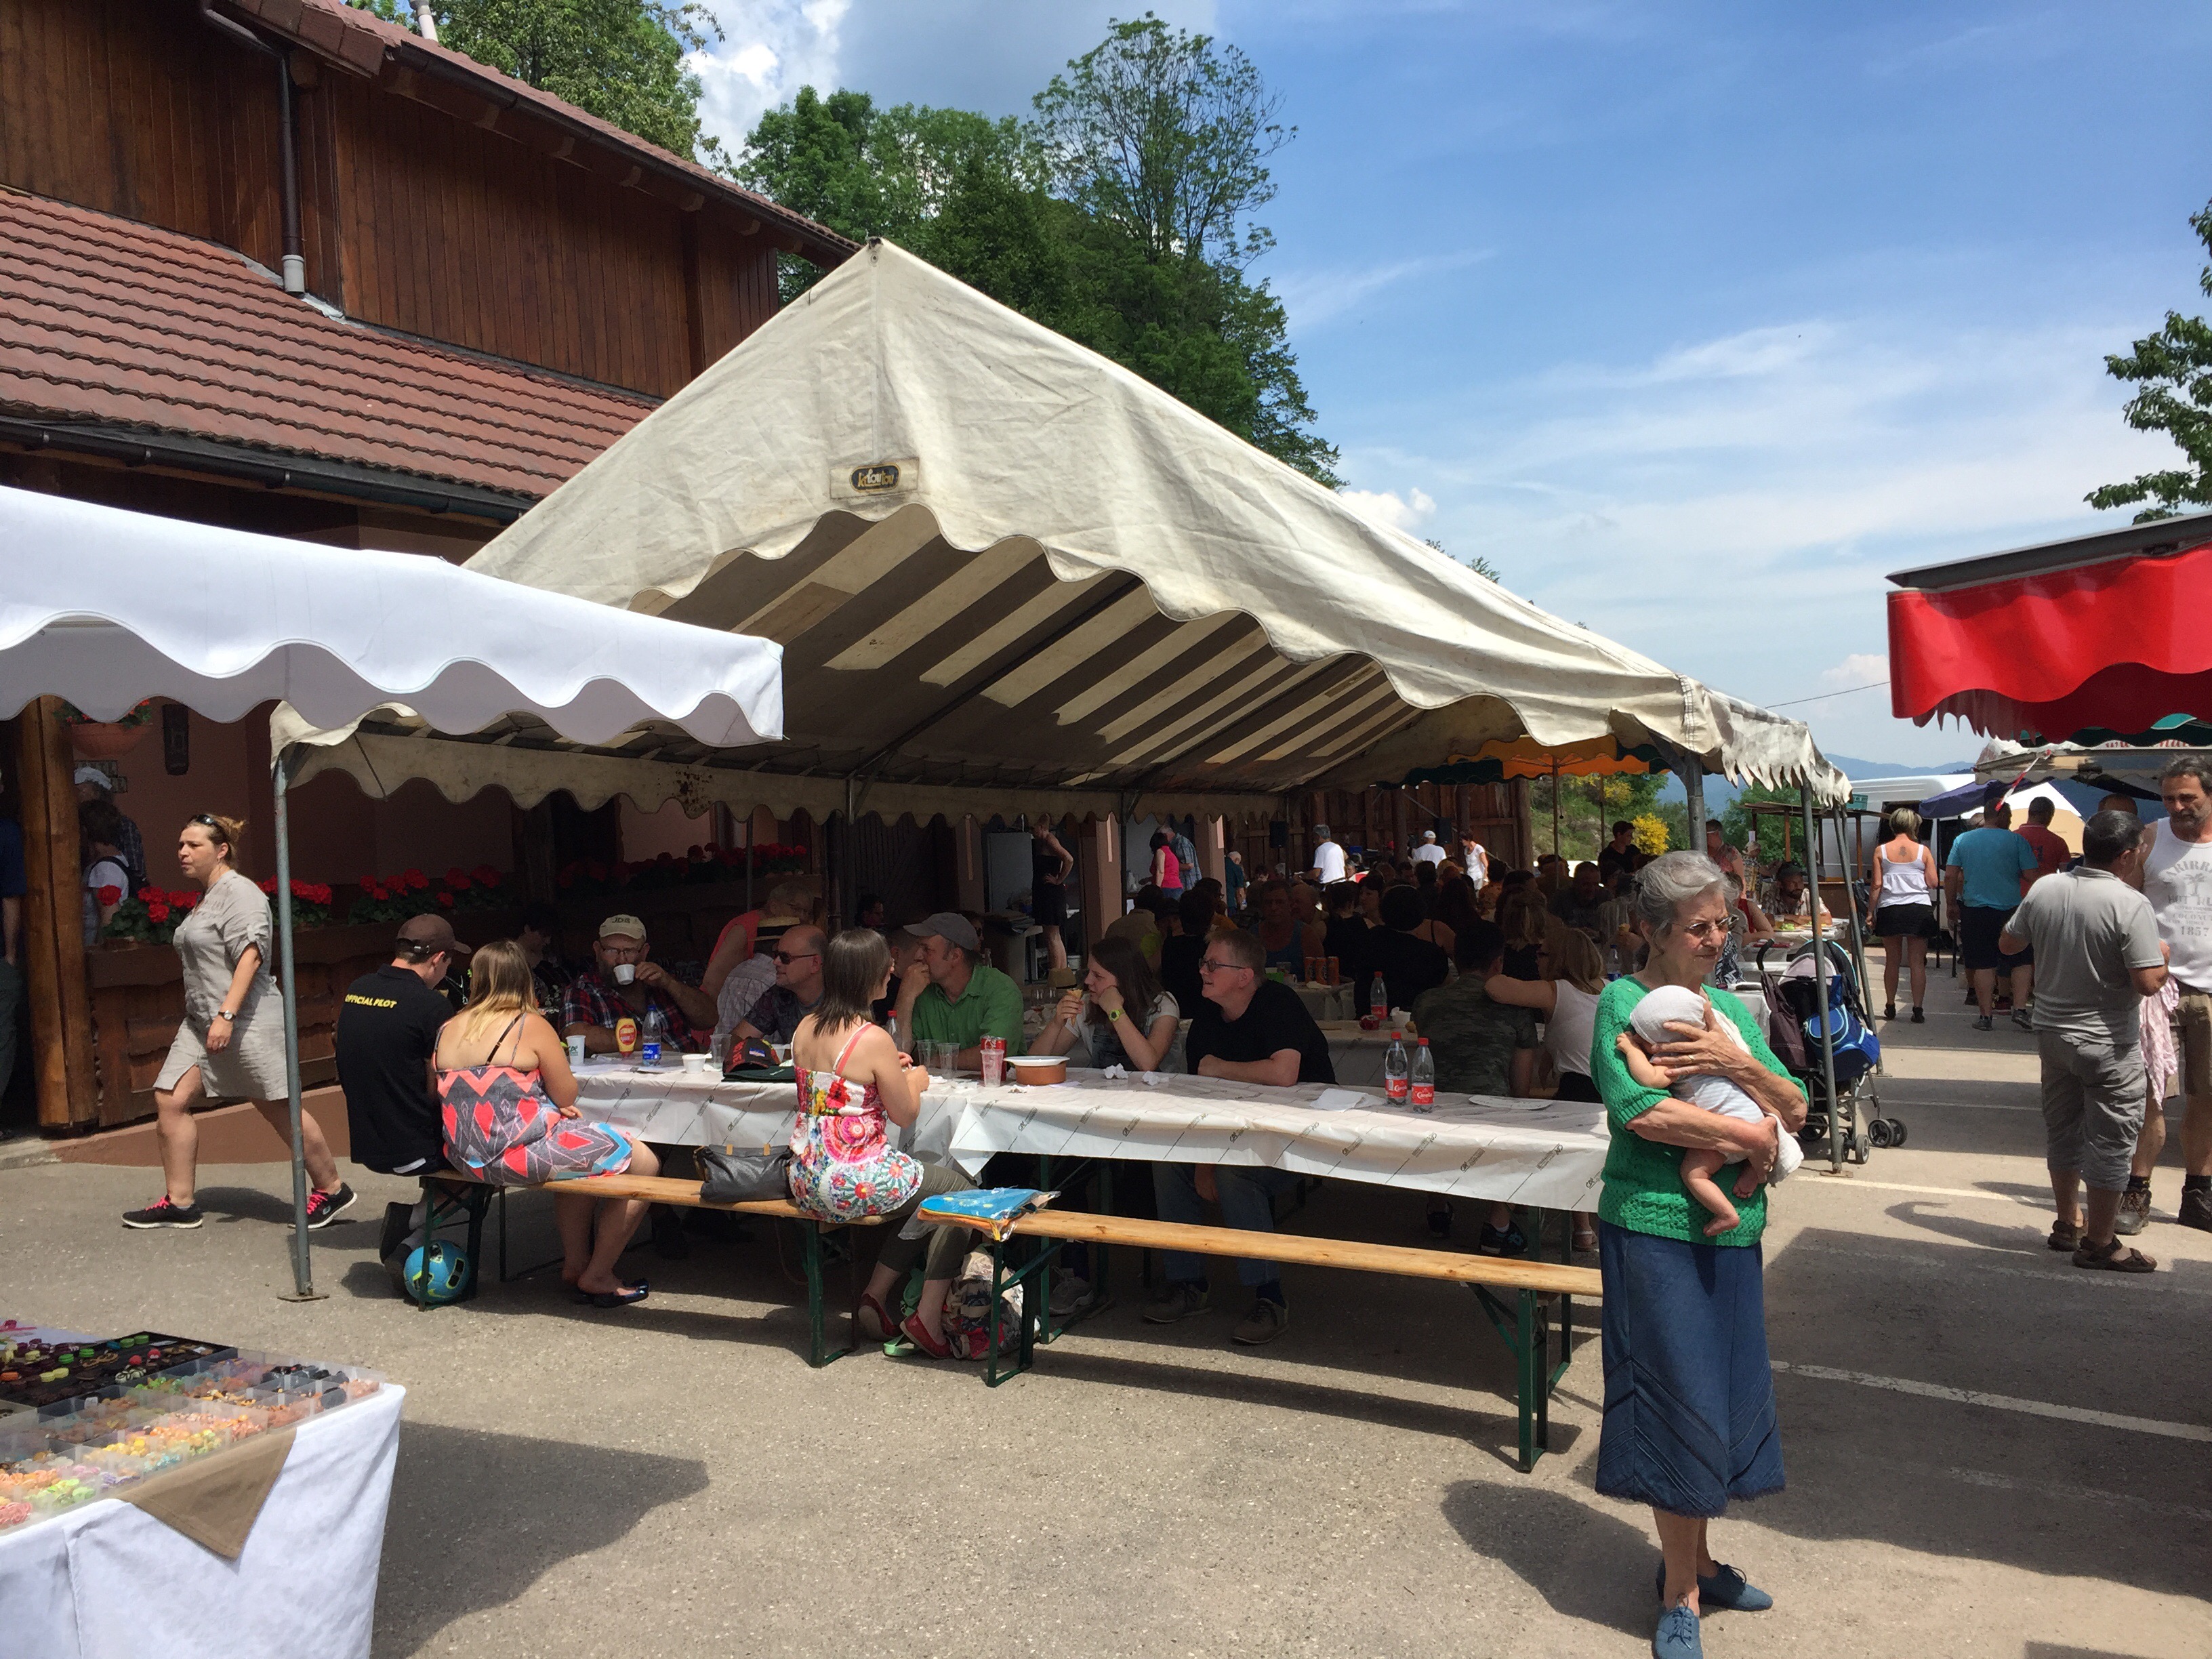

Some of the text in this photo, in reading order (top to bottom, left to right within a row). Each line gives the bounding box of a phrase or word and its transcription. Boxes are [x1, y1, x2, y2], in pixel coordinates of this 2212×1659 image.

[2181, 926, 2210, 937] 1857
[345, 994, 397, 1008] OFFICIAL PILOT
